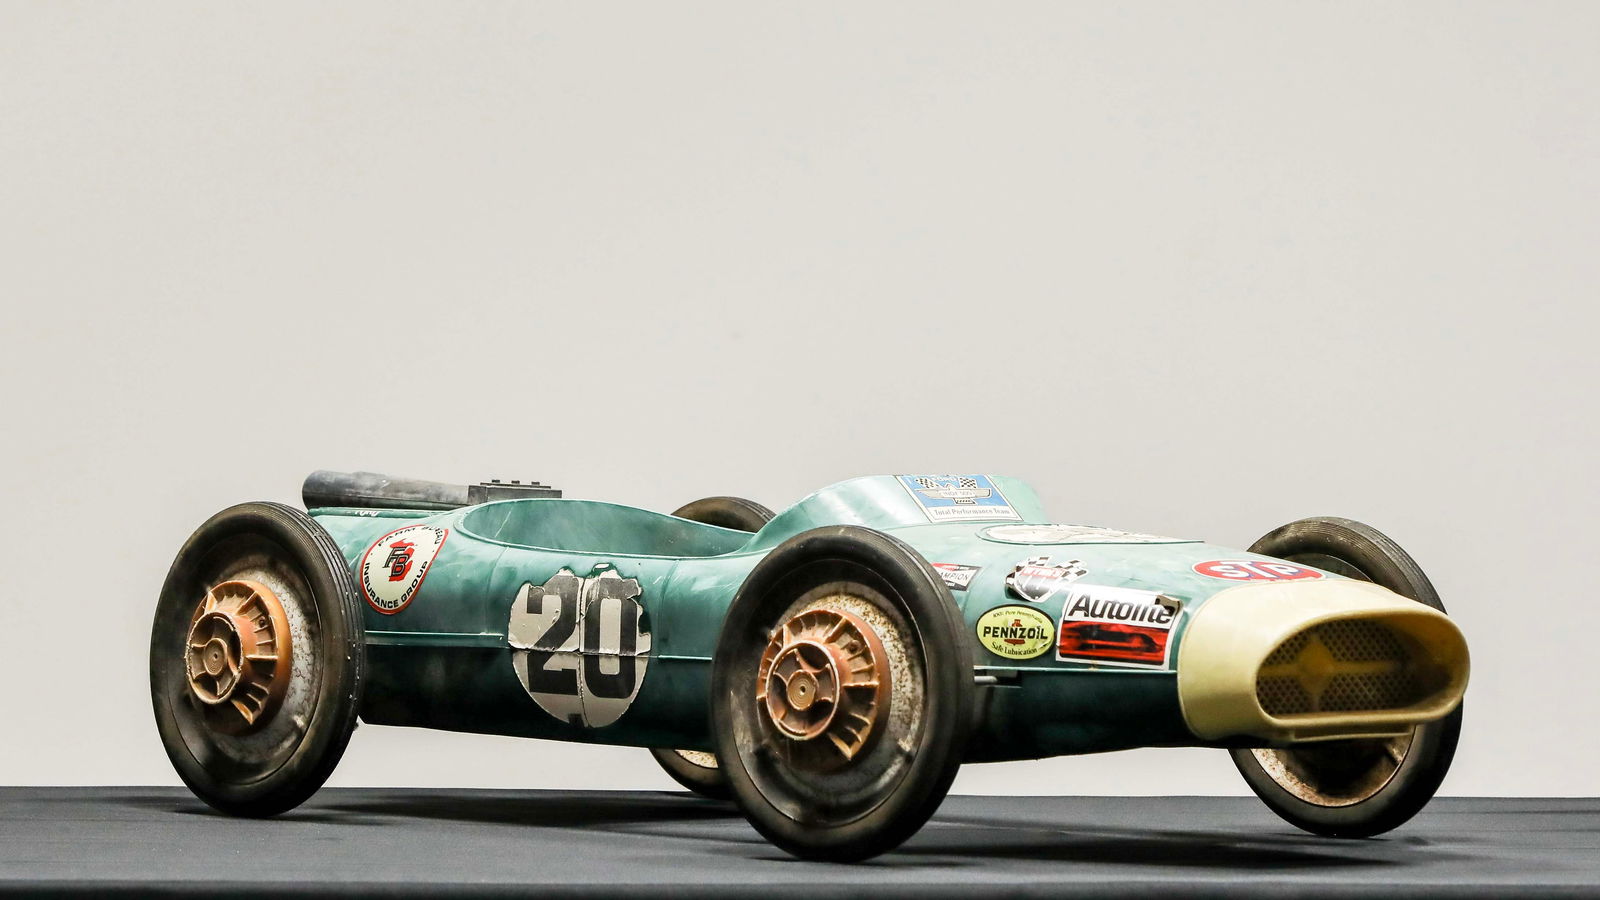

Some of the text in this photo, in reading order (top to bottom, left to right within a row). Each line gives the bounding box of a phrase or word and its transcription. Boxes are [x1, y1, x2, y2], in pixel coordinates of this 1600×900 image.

[952, 508, 993, 516] Performance
[378, 527, 416, 547] FARM
[940, 571, 969, 580] AMPION
[1208, 560, 1300, 578] STP
[363, 560, 428, 609] INSURANCE GROUP
[1068, 593, 1175, 625] Autolite
[526, 574, 640, 699] 20
[983, 625, 1049, 640] PENNZOIL
[992, 641, 1038, 656] Safe Lubrication
